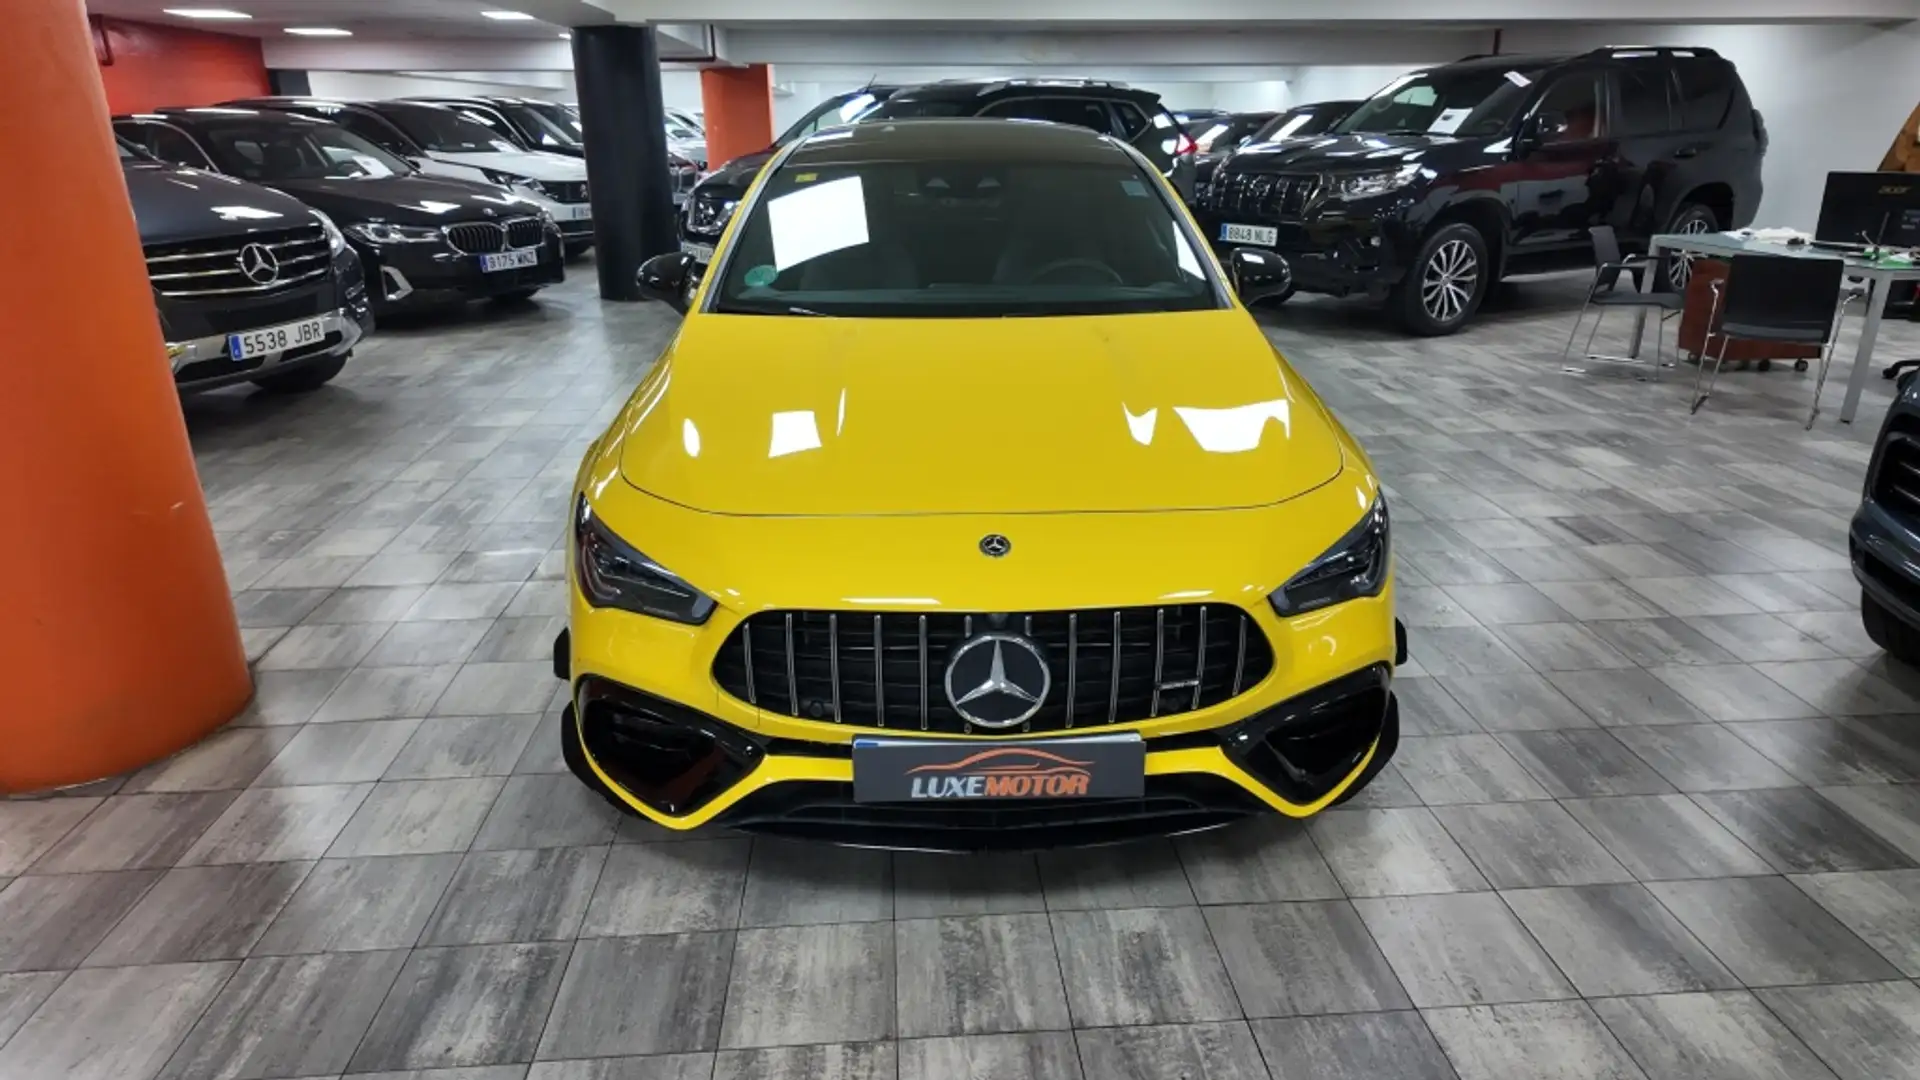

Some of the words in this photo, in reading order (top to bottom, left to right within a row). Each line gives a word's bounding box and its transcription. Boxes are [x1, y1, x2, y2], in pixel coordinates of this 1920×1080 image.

[243, 330, 288, 354] 5538
[294, 321, 321, 344] JBR
[911, 774, 1091, 798] LUXEMOTOR
